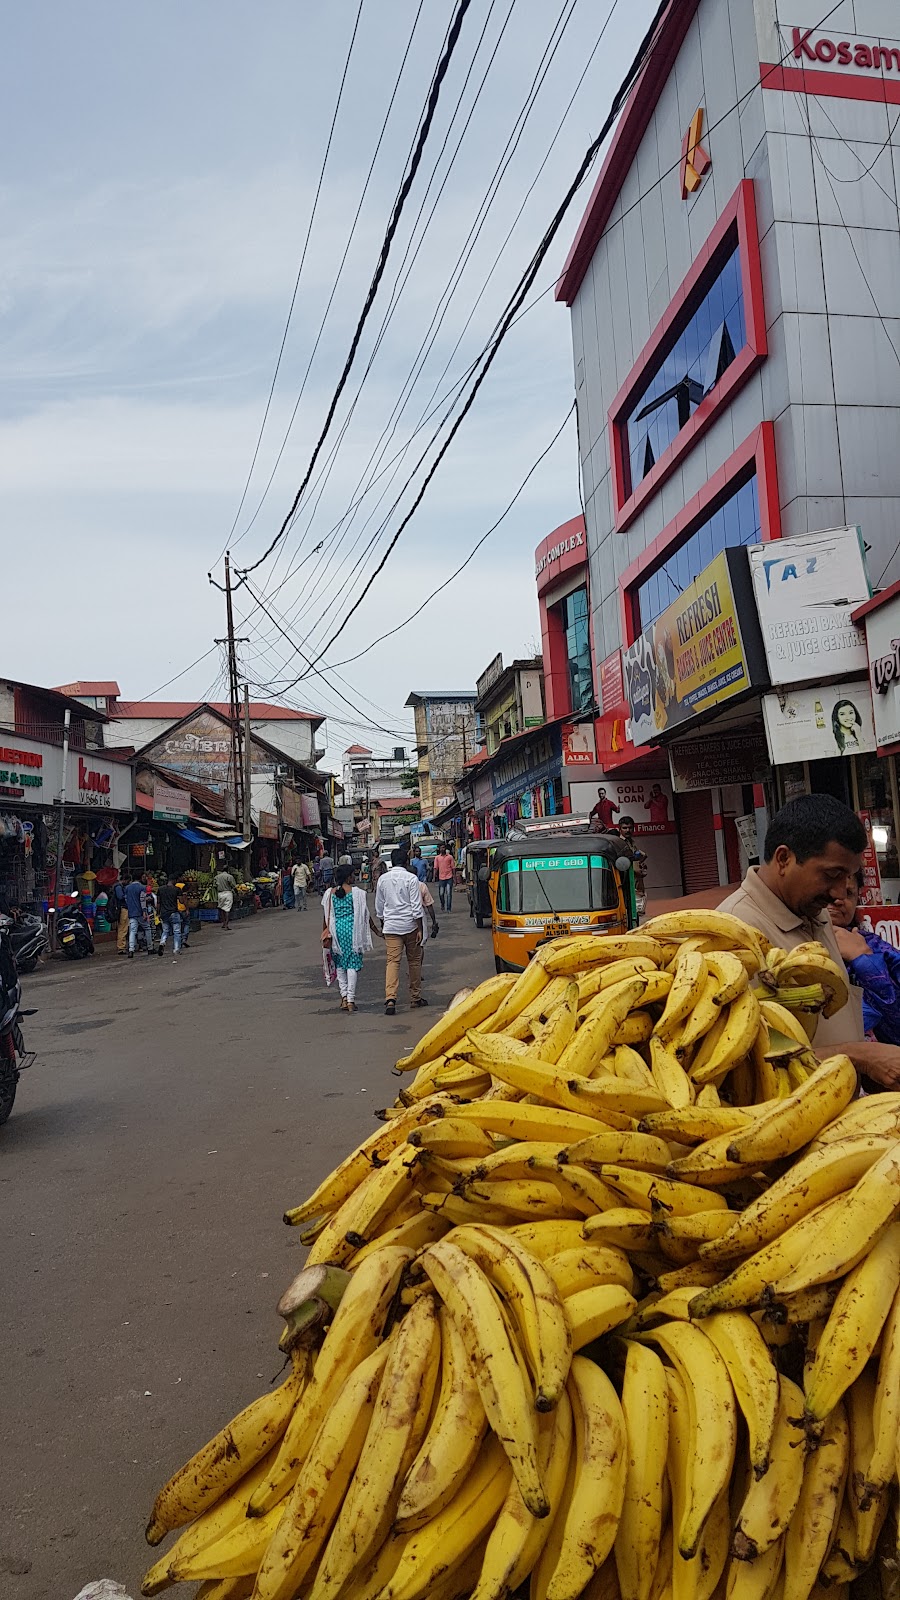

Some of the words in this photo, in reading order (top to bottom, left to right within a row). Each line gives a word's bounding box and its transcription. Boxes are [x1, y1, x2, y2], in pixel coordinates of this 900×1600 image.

[792, 27, 900, 72] Kosam
[547, 531, 584, 564] COMPLEX
[676, 581, 722, 647] REFRESH
[768, 617, 819, 640] REFRESH
[821, 612, 855, 631] BAKE
[775, 644, 787, 660] &
[787, 638, 819, 662] JUICE
[821, 630, 866, 652] CENTRE
[674, 744, 699, 756] REFRESH
[699, 741, 720, 754] BAKERS
[727, 738, 743, 750] JUICE
[743, 737, 764, 749] CENTRE
[713, 759, 740, 768] COFFEE
[617, 785, 644, 794] GOLD
[618, 795, 645, 803] LOAN
[637, 824, 665, 832] Finance
